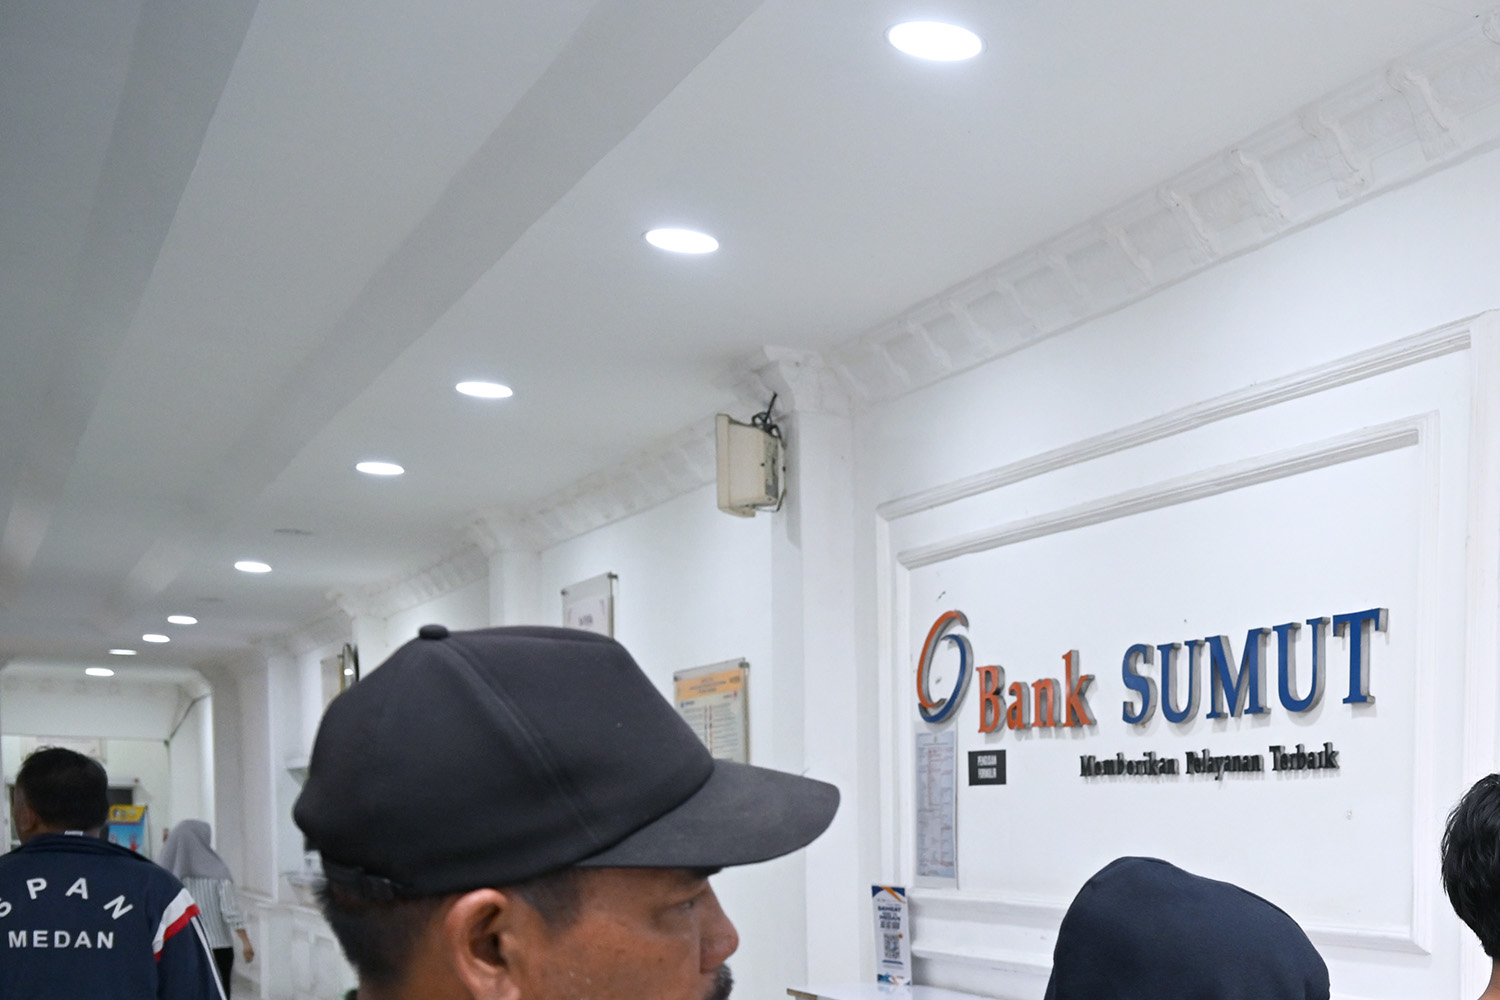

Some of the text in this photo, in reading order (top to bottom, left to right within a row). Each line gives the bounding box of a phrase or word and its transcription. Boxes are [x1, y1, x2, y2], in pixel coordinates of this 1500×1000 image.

[975, 607, 1389, 733] Bank SUMUT
[8, 930, 114, 949] MEDAN
